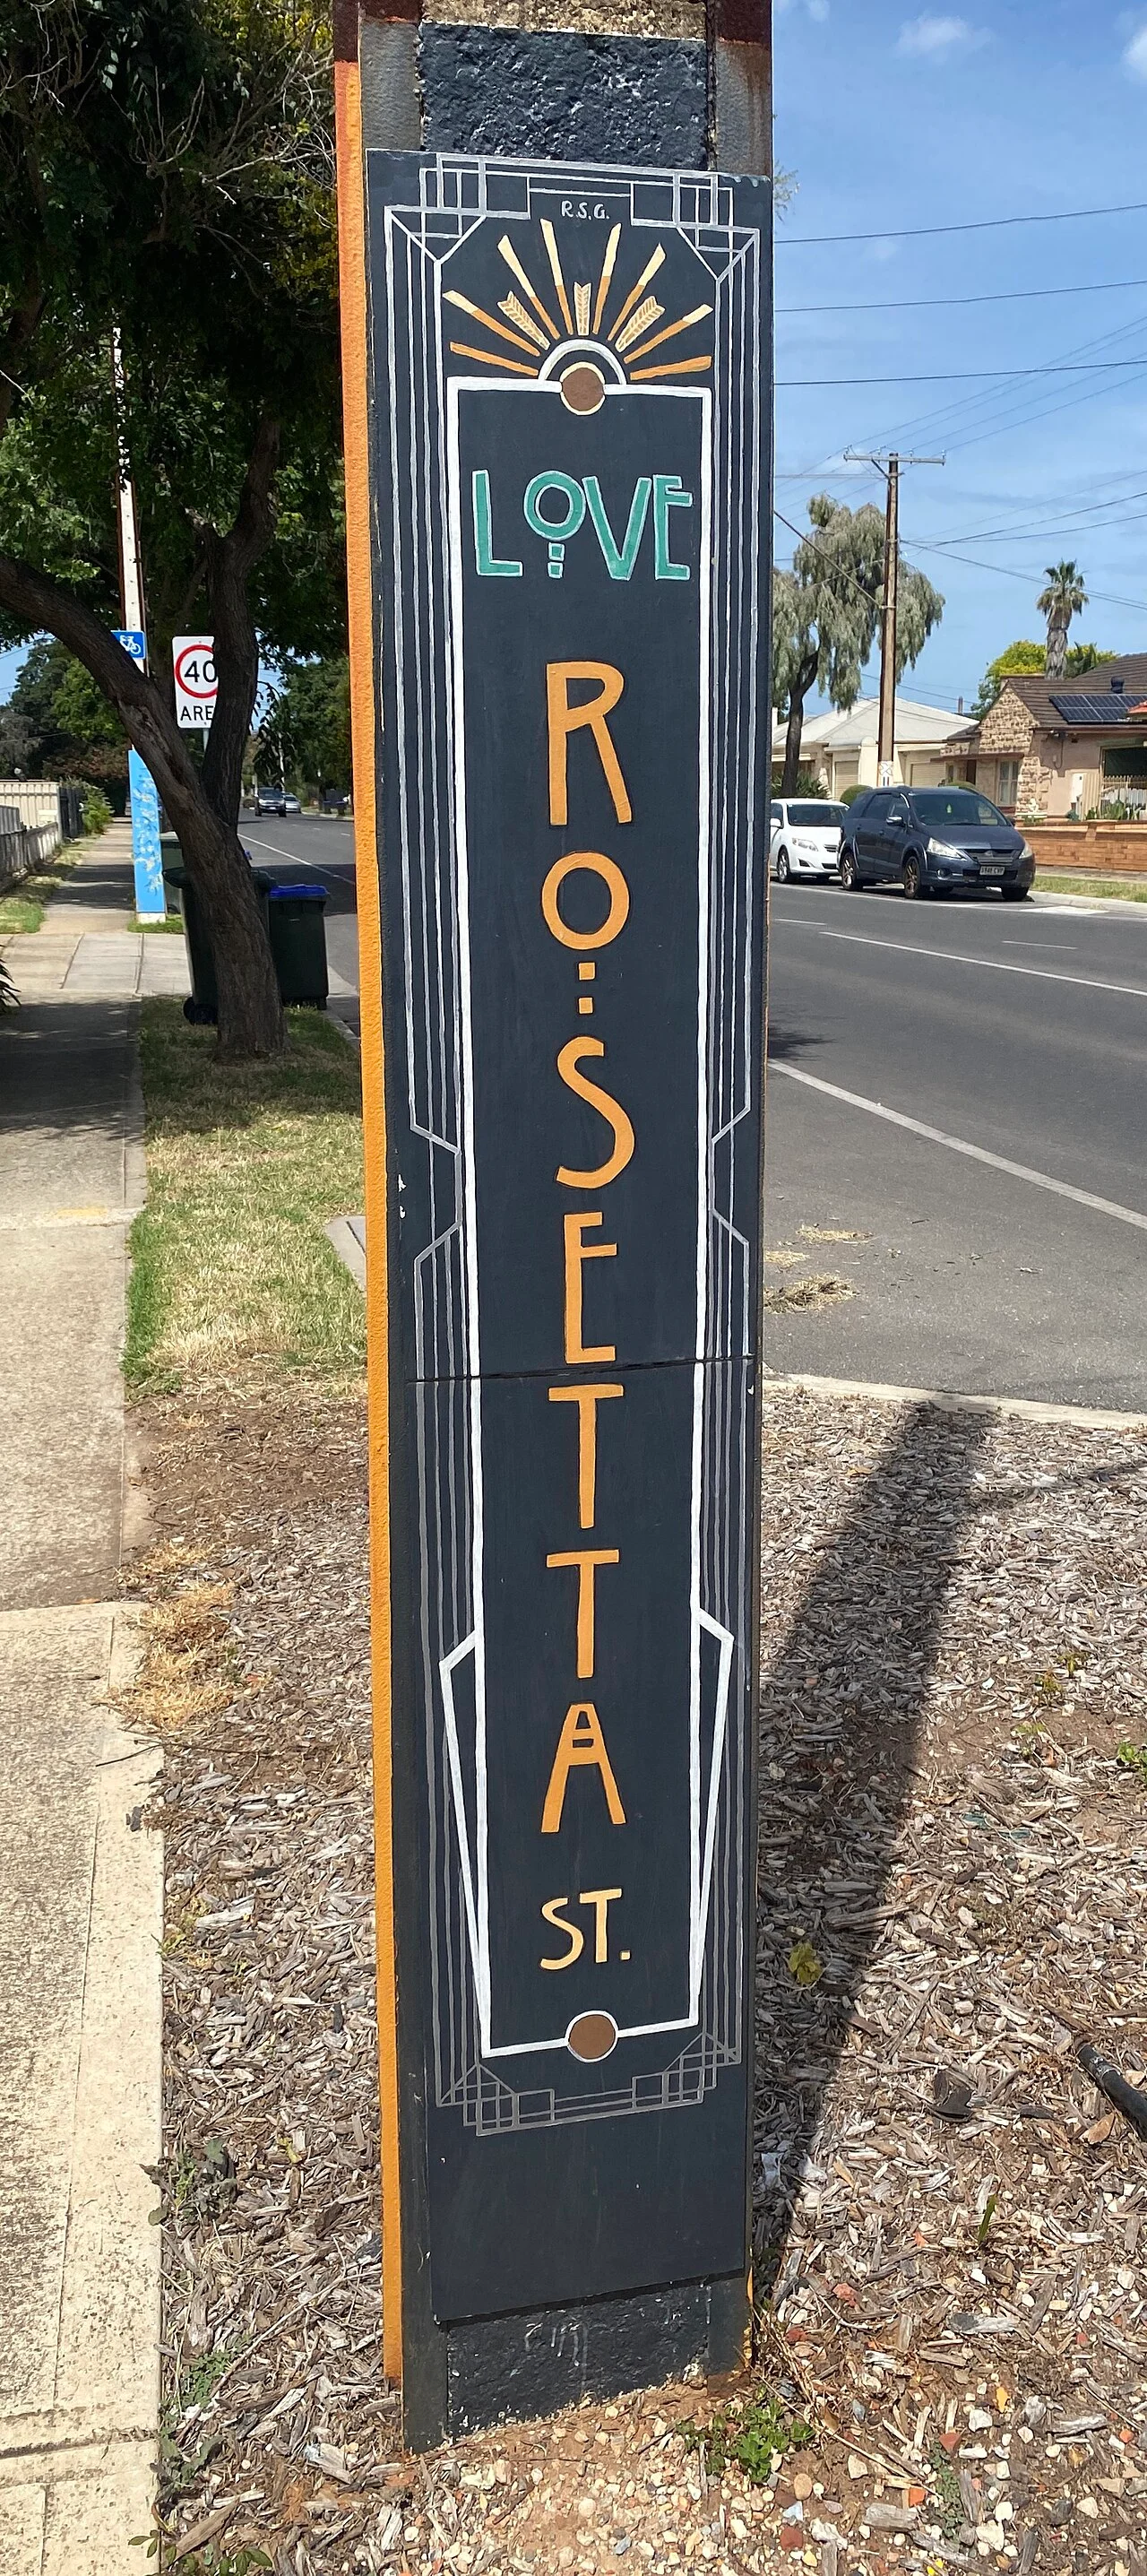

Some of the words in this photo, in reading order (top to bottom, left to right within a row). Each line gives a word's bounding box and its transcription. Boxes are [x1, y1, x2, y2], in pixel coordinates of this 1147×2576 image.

[471, 469, 693, 581] LOVE
[184, 660, 218, 683] 40
[540, 660, 635, 1834] ROSETTA
[539, 1887, 632, 1971] ST.
